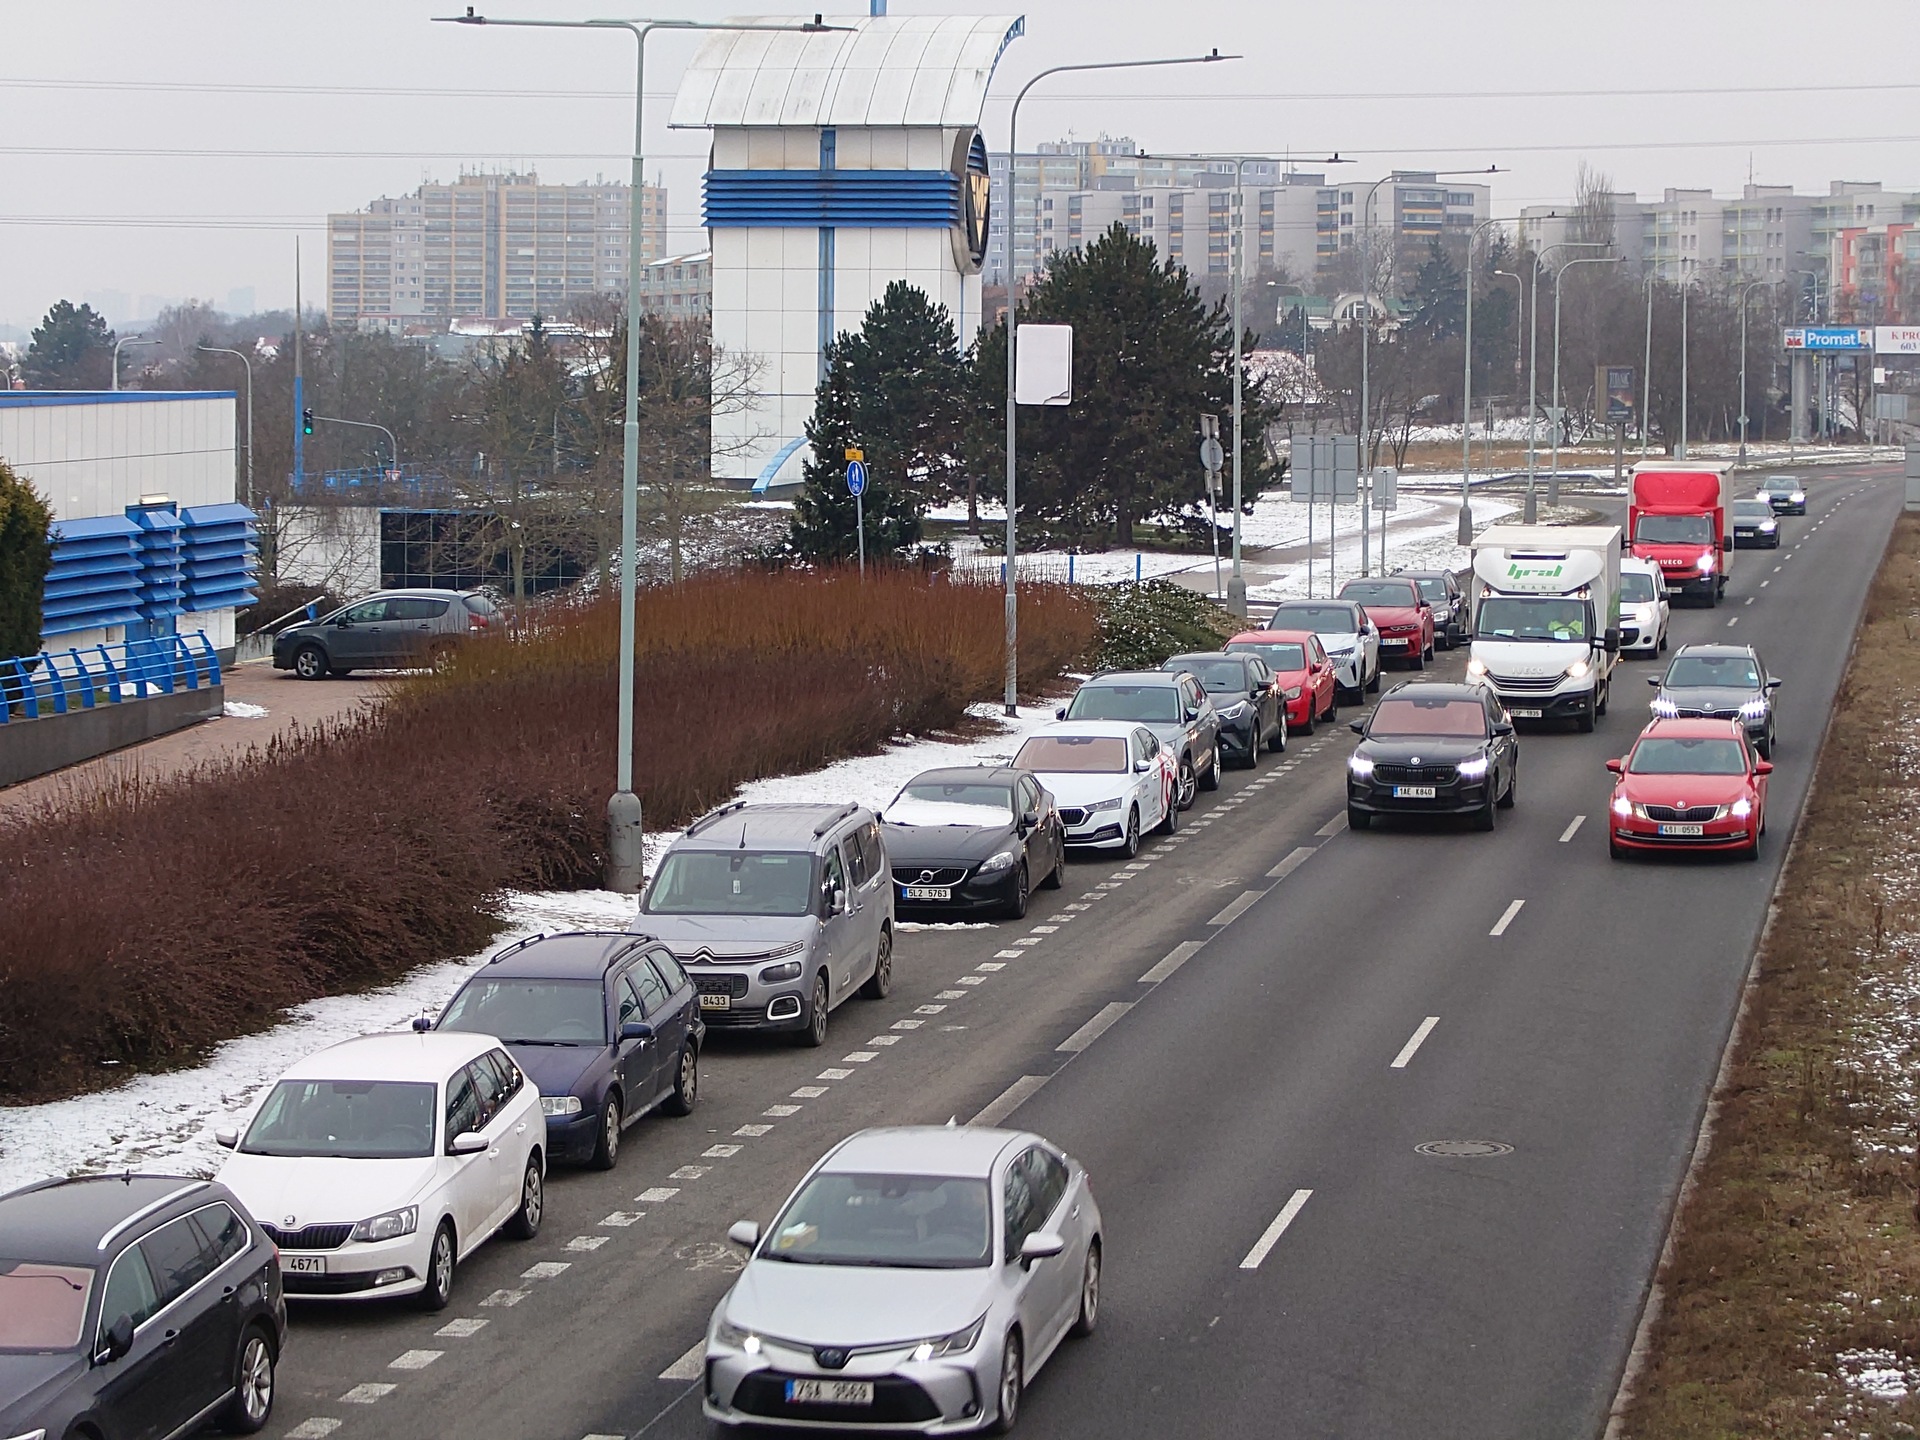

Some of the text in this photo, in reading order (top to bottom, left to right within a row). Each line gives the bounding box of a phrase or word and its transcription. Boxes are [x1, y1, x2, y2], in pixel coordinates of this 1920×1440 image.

[1807, 332, 1856, 345] Promat
[1891, 331, 1899, 340] K
[1900, 342, 1917, 351] 603
[1512, 667, 1544, 675] IVECO
[1415, 788, 1433, 796] K840
[1681, 825, 1700, 833] 0553
[908, 889, 947, 898] 5L2 5763
[703, 995, 726, 1006] 8433
[290, 1258, 319, 1271] 4671
